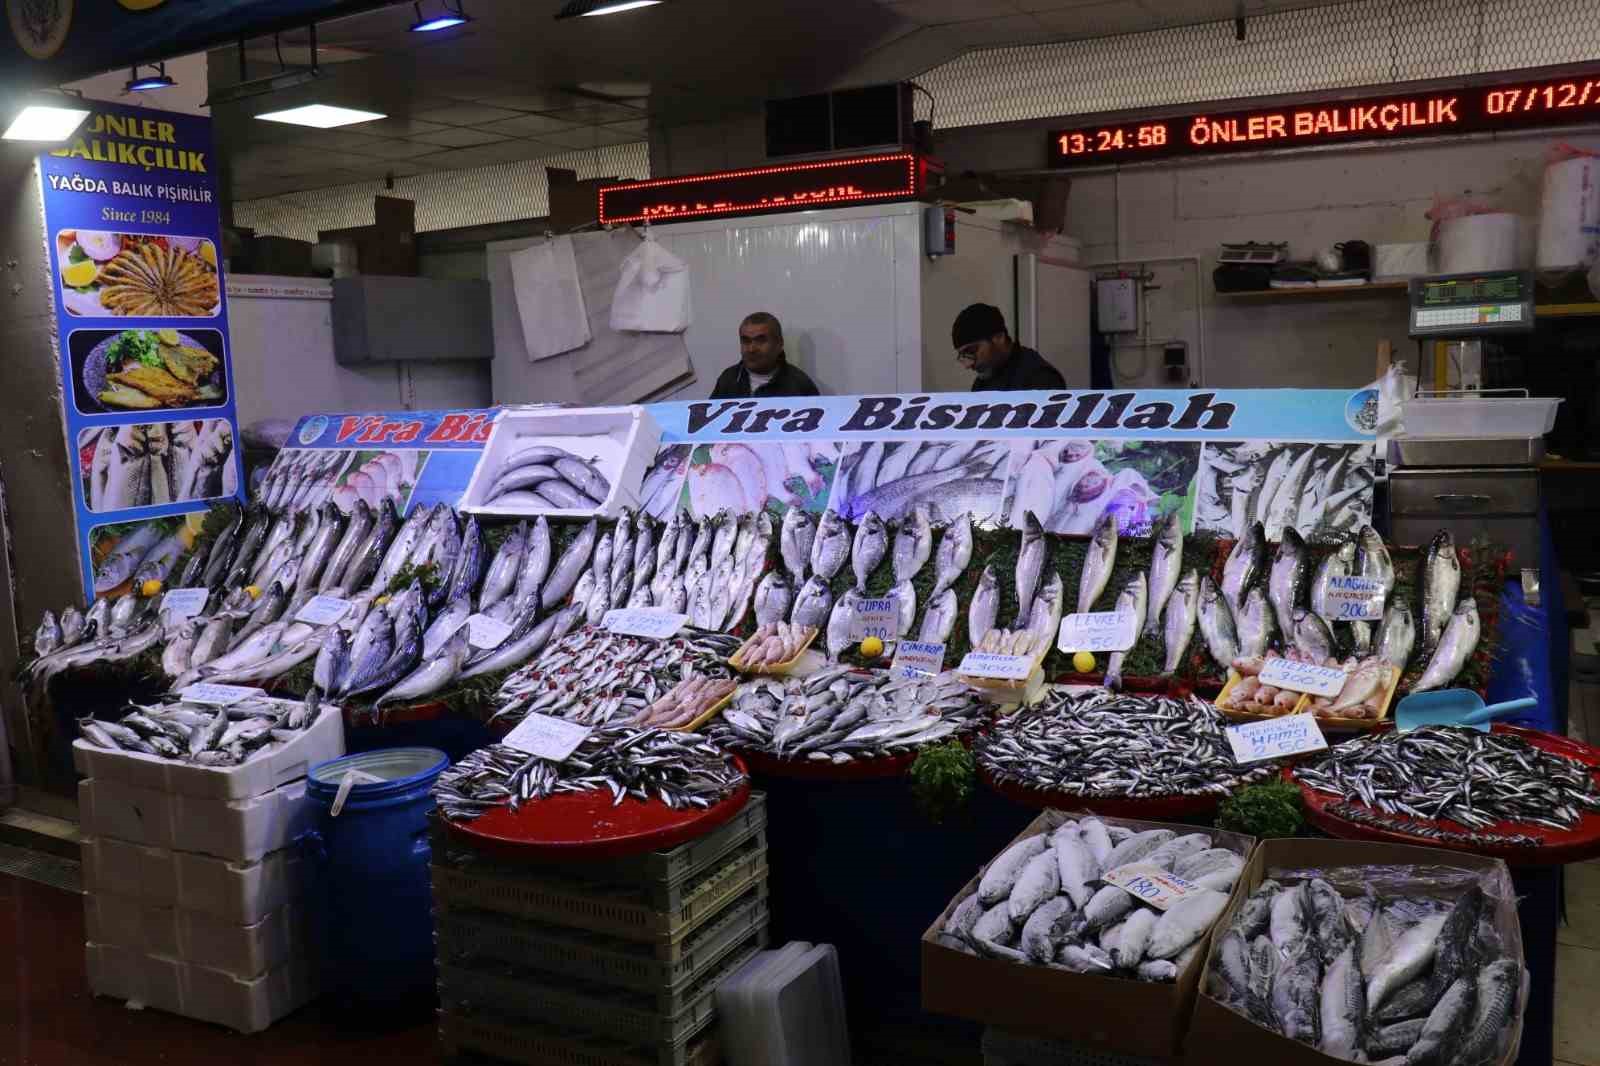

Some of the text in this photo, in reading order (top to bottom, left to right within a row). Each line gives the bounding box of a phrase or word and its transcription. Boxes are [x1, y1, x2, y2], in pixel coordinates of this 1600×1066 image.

[1058, 125, 1167, 154] 13:24:58
[1190, 117, 1287, 144] ÖNLER
[48, 173, 213, 204] YAĞDA BALIK PİŞİRİLİR
[101, 207, 171, 225] Since 1984
[336, 414, 424, 443] Vira
[687, 393, 1237, 434] Vira Bismillah
[1125, 876, 1161, 898] 180
